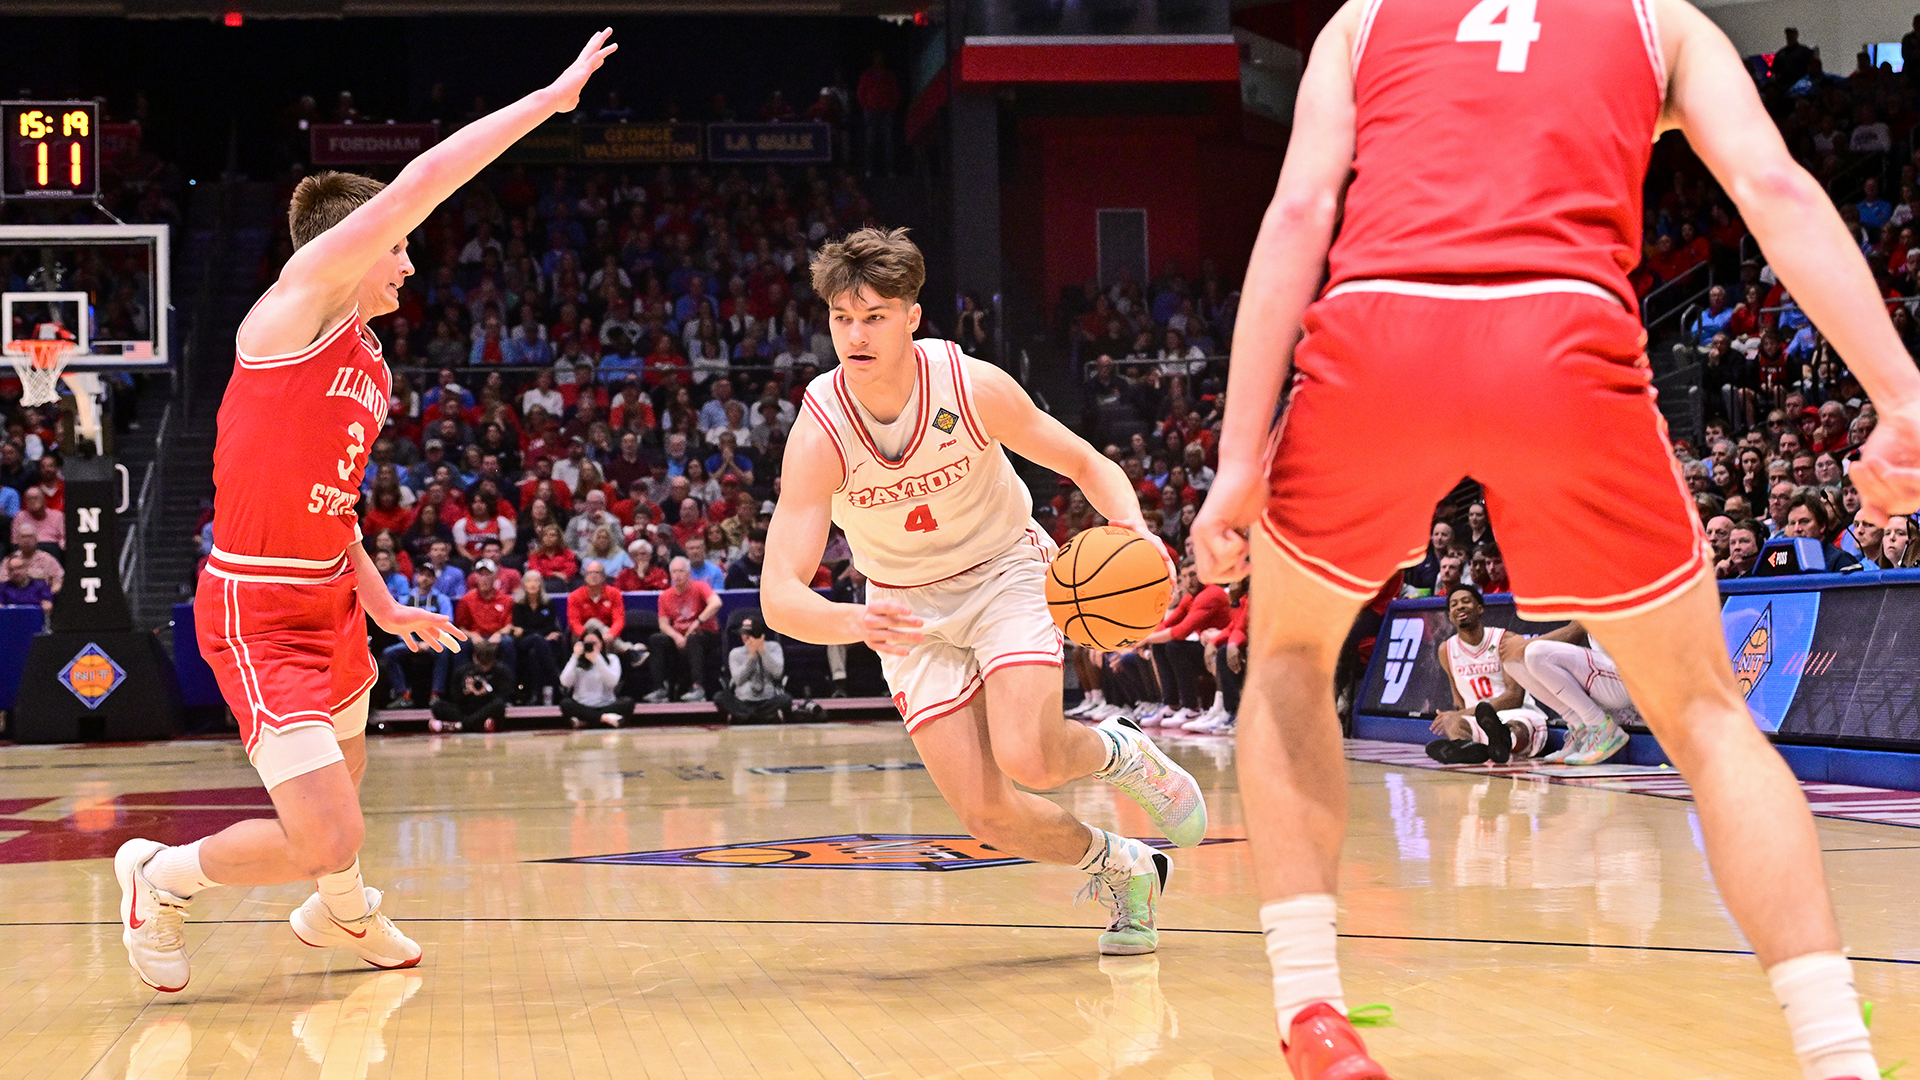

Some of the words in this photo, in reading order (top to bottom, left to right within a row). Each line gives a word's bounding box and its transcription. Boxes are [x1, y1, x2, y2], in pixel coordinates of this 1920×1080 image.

[1455, 0, 1541, 73] 4
[20, 110, 89, 139] 15:19
[604, 128, 673, 142] GEORGE
[329, 137, 420, 151] FORDHAM
[583, 143, 697, 157] WASHINGTON
[38, 141, 81, 186] 11
[337, 421, 365, 481] 3
[849, 456, 970, 508] DAYTON
[904, 504, 939, 533] 4
[77, 507, 102, 603] NIT
[74, 670, 110, 681] NIT
[1455, 662, 1501, 677] DAYTON
[1738, 652, 1765, 673] NIT
[1469, 676, 1493, 700] 10
